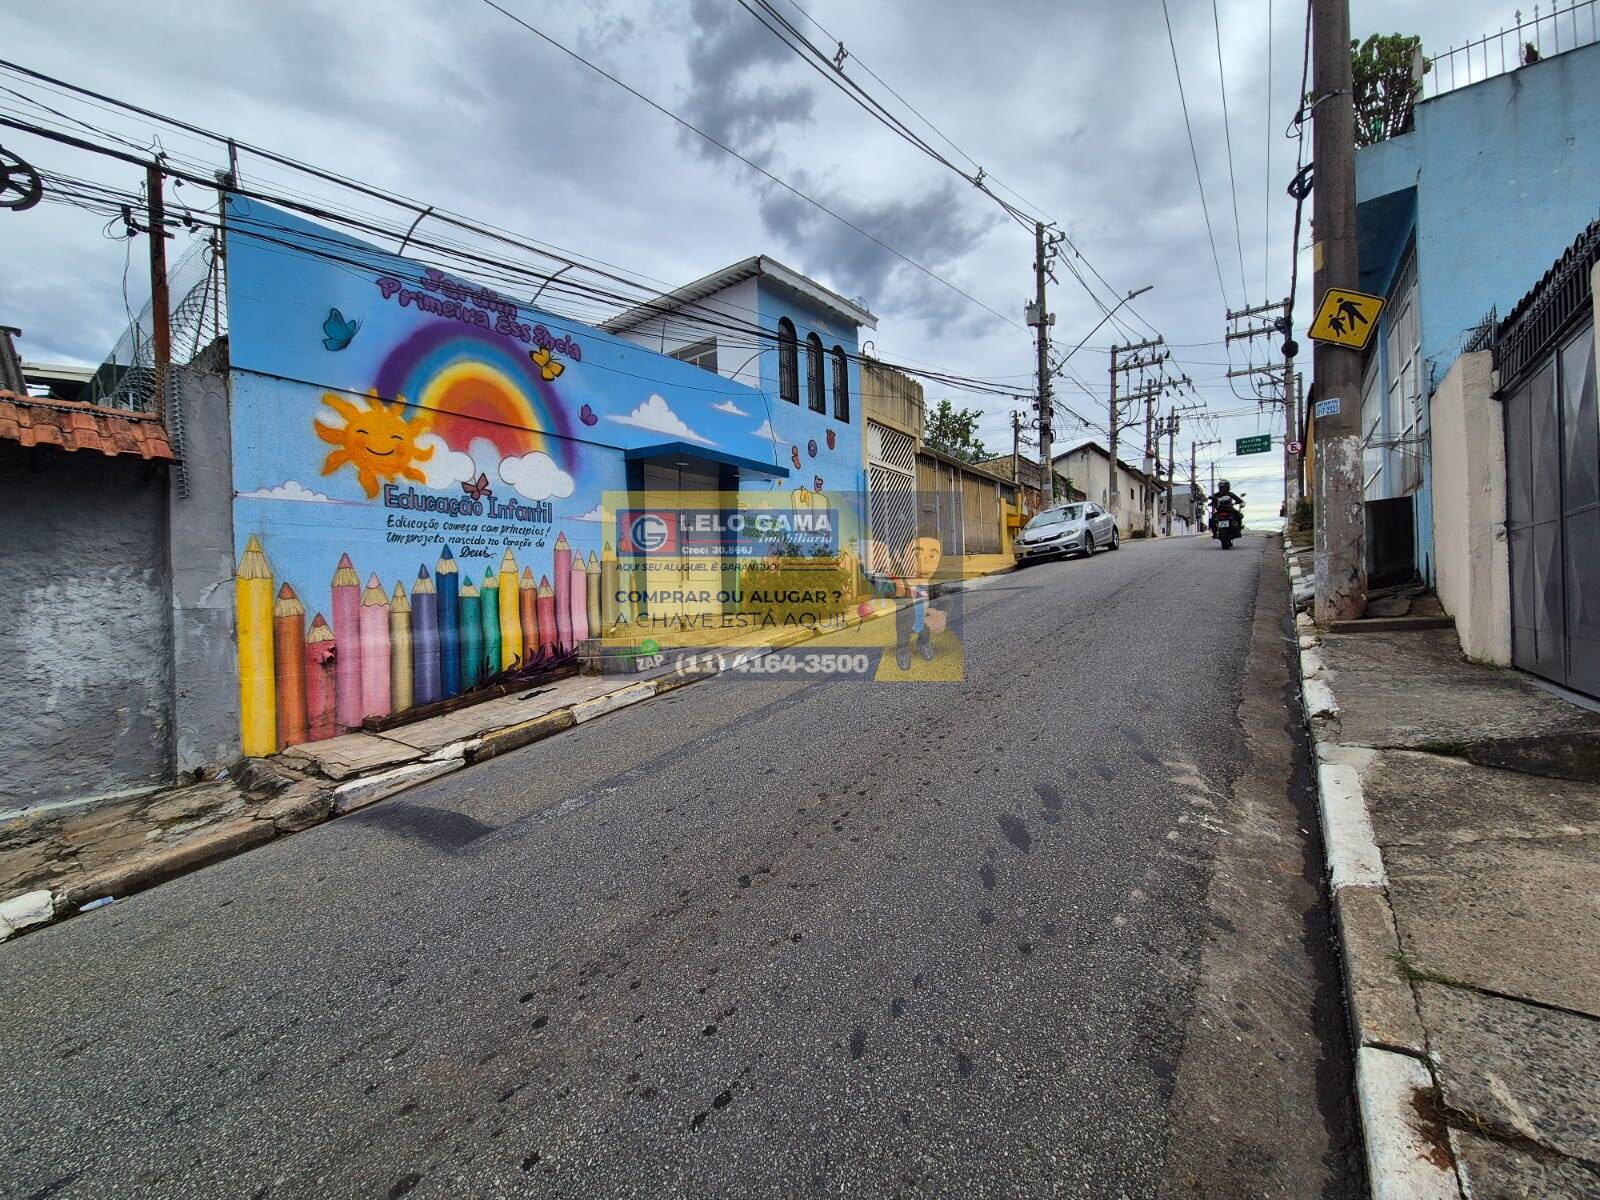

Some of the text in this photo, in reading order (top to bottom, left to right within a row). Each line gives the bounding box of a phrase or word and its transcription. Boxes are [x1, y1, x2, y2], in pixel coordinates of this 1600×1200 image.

[376, 276, 490, 330] Primeira
[383, 483, 553, 524] Educação Infantil
[386, 514, 440, 532] Educação
